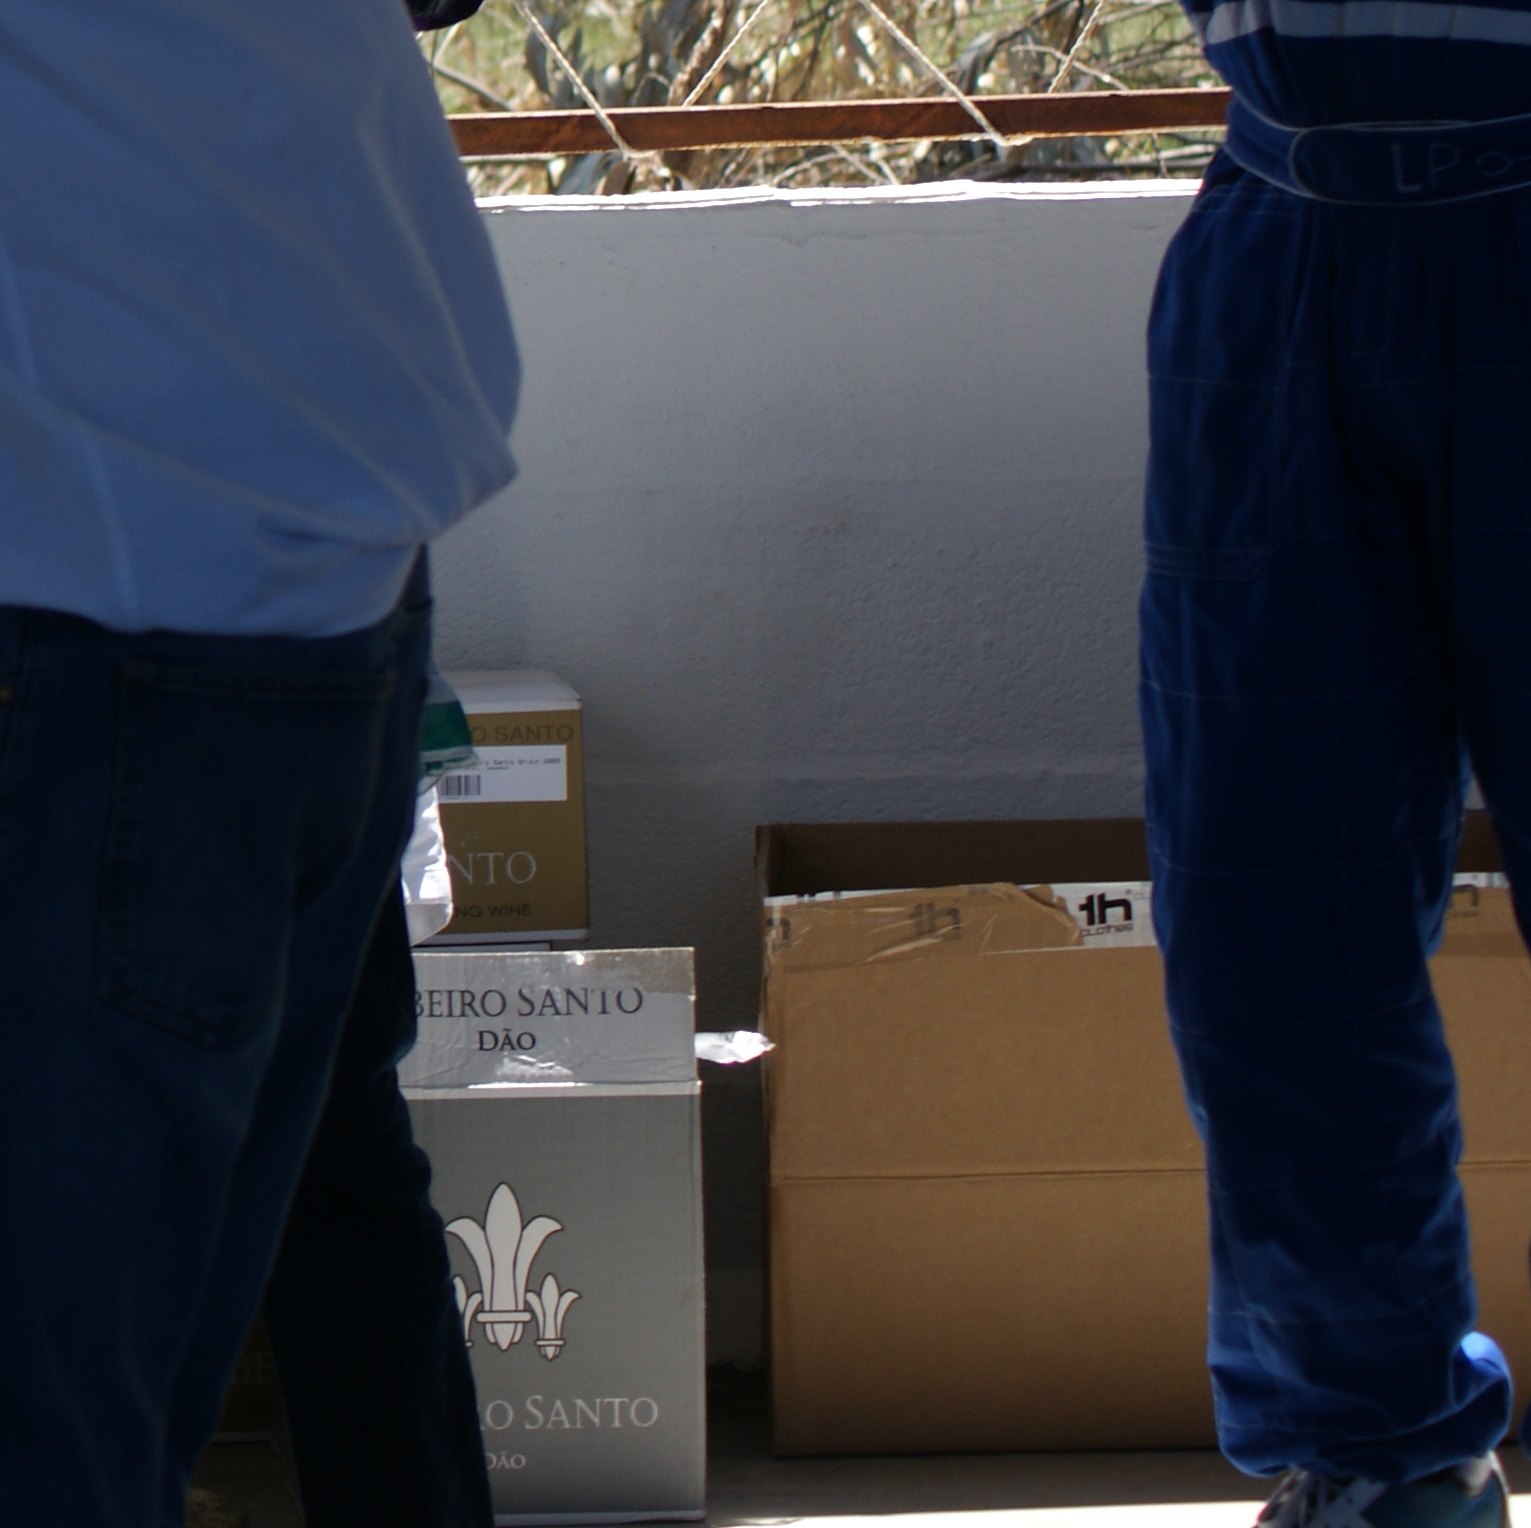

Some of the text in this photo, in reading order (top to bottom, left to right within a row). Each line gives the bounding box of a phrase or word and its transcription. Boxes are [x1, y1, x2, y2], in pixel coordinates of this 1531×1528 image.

[495, 724, 573, 743] SANTO
[446, 850, 537, 885] NTO
[488, 903, 532, 917] WINE
[516, 987, 643, 1017] SANTO
[478, 1028, 536, 1052] DÃO
[524, 1394, 660, 1430] SANTO
